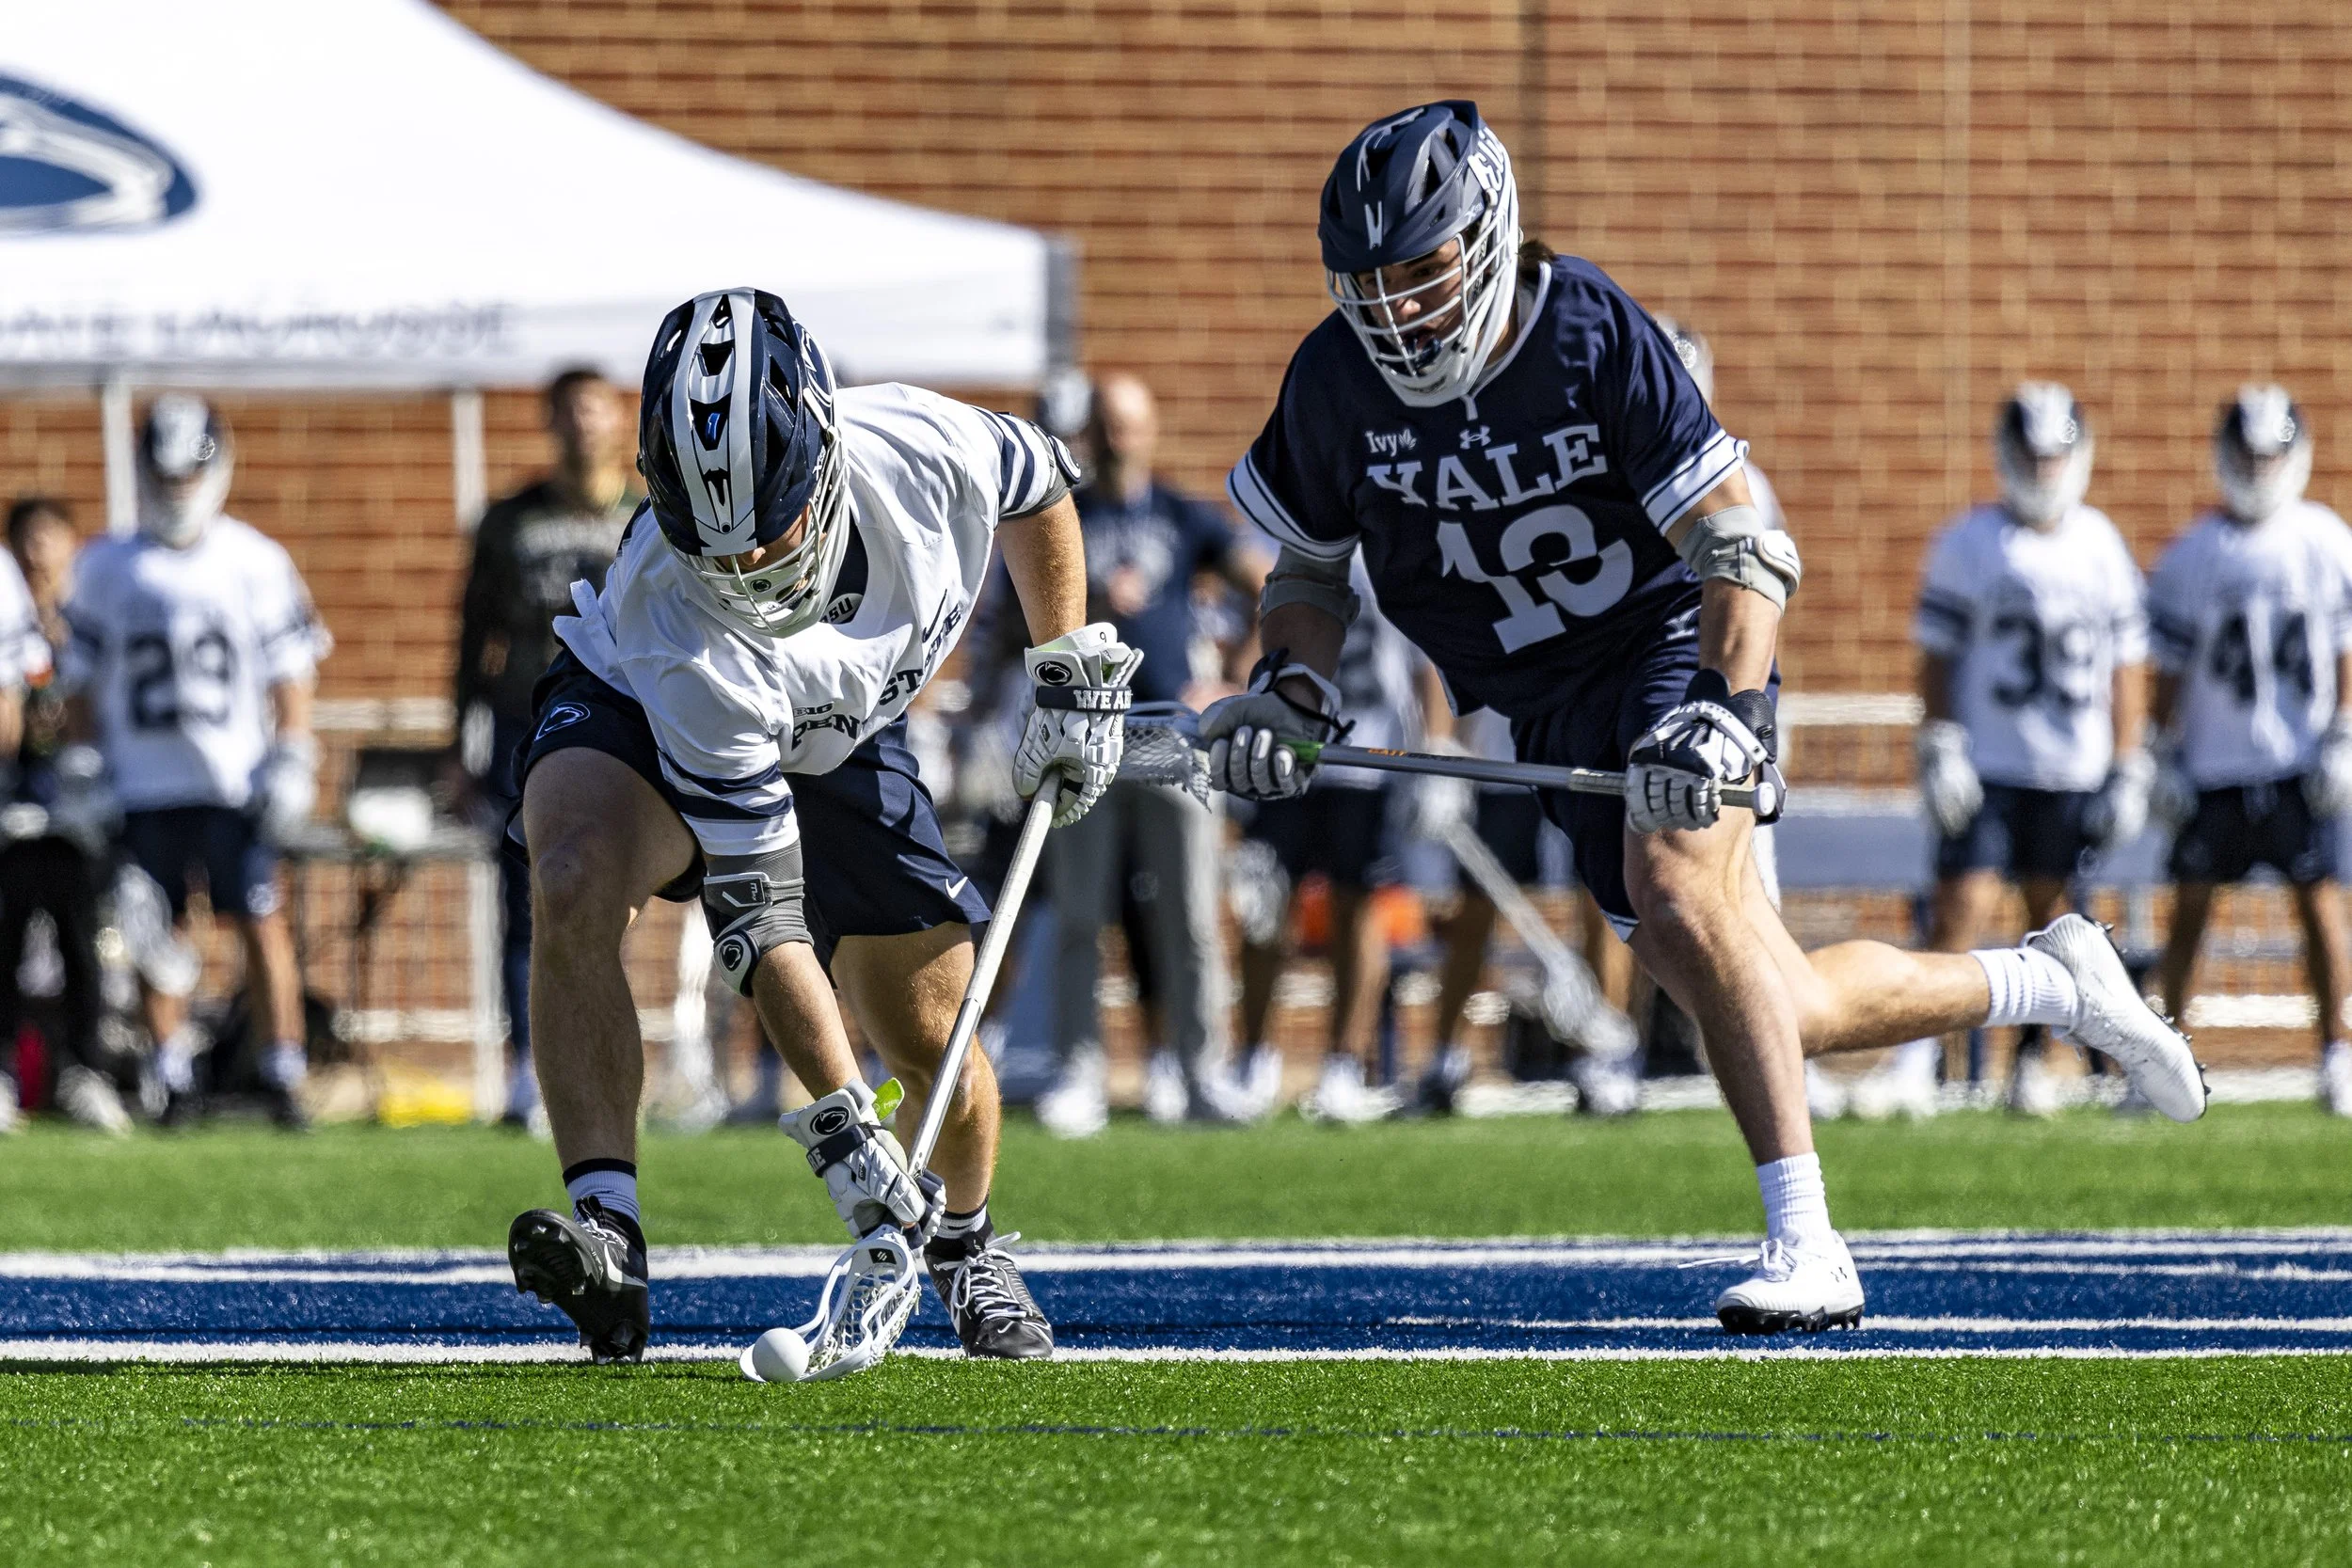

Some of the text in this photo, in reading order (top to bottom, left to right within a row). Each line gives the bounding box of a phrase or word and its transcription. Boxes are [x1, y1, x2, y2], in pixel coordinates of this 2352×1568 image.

[1365, 431, 1398, 457] Ivy
[1367, 424, 1608, 510] YALE
[791, 714, 869, 751] PEN
